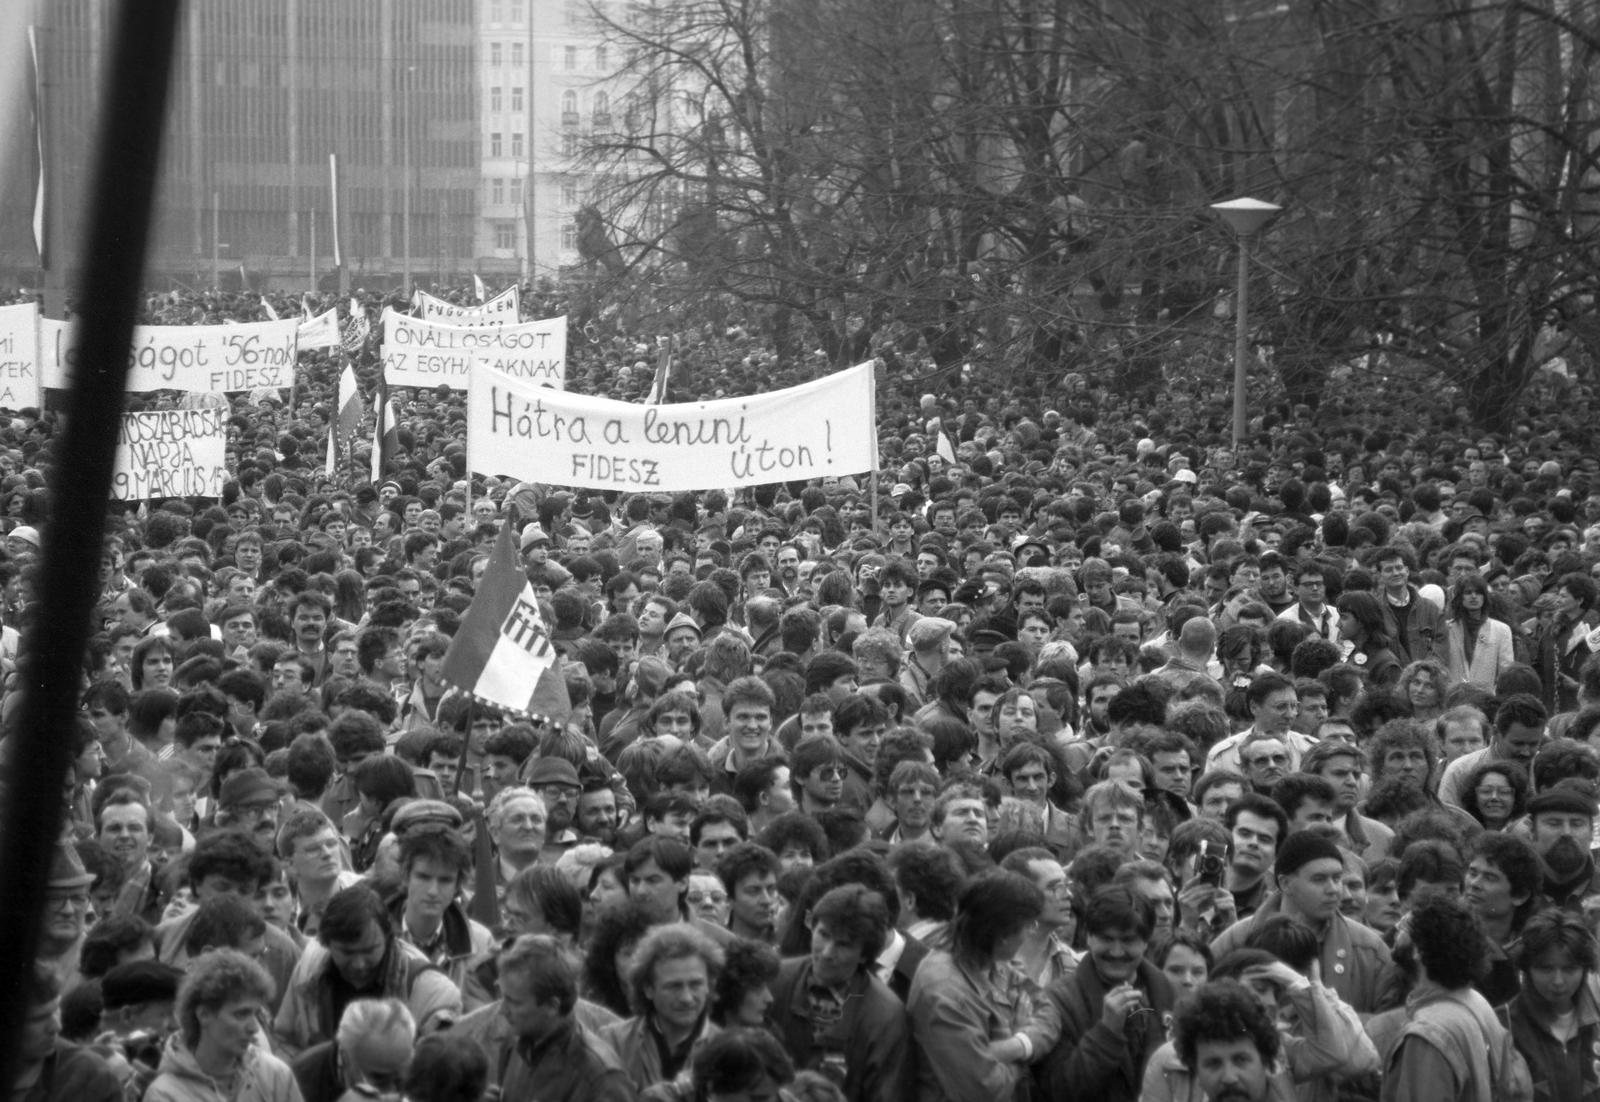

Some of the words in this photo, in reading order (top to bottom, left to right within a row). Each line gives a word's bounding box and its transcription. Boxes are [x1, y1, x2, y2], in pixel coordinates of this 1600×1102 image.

[395, 321, 553, 349] ÖNÁLLÓSÁGOT
[384, 353, 407, 371] AZ
[210, 367, 283, 390] FIDESZ
[492, 386, 592, 444] Hátra
[604, 419, 630, 445] a
[643, 405, 753, 446] lenini
[130, 441, 195, 470] NAPJA
[572, 454, 661, 486] FIDESZ
